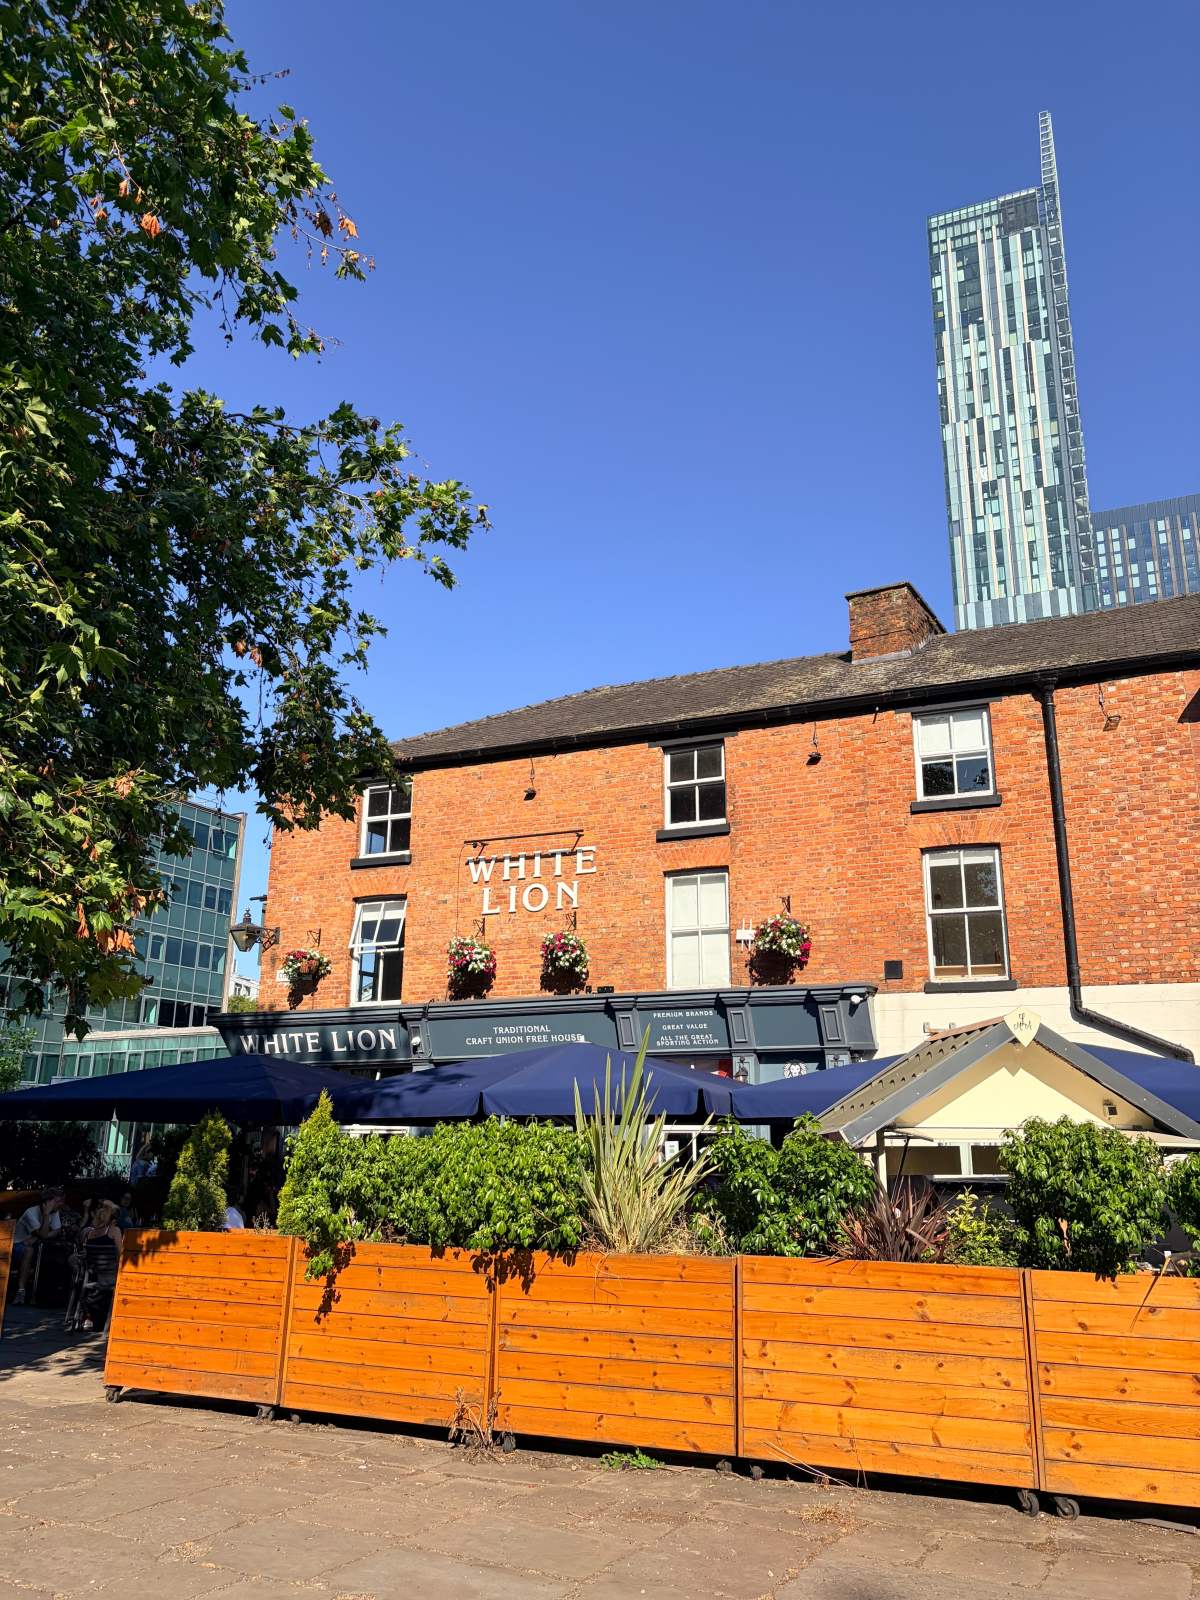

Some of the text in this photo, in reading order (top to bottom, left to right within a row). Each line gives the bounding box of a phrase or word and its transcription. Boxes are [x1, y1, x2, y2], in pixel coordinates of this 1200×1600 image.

[467, 845, 597, 883] WHITE
[482, 880, 579, 915] LION
[239, 1028, 397, 1054] WHITE LION
[465, 1033, 582, 1045] CRAFT UNION FREE HOUSE
[492, 1024, 551, 1034] TRADITIONAL
